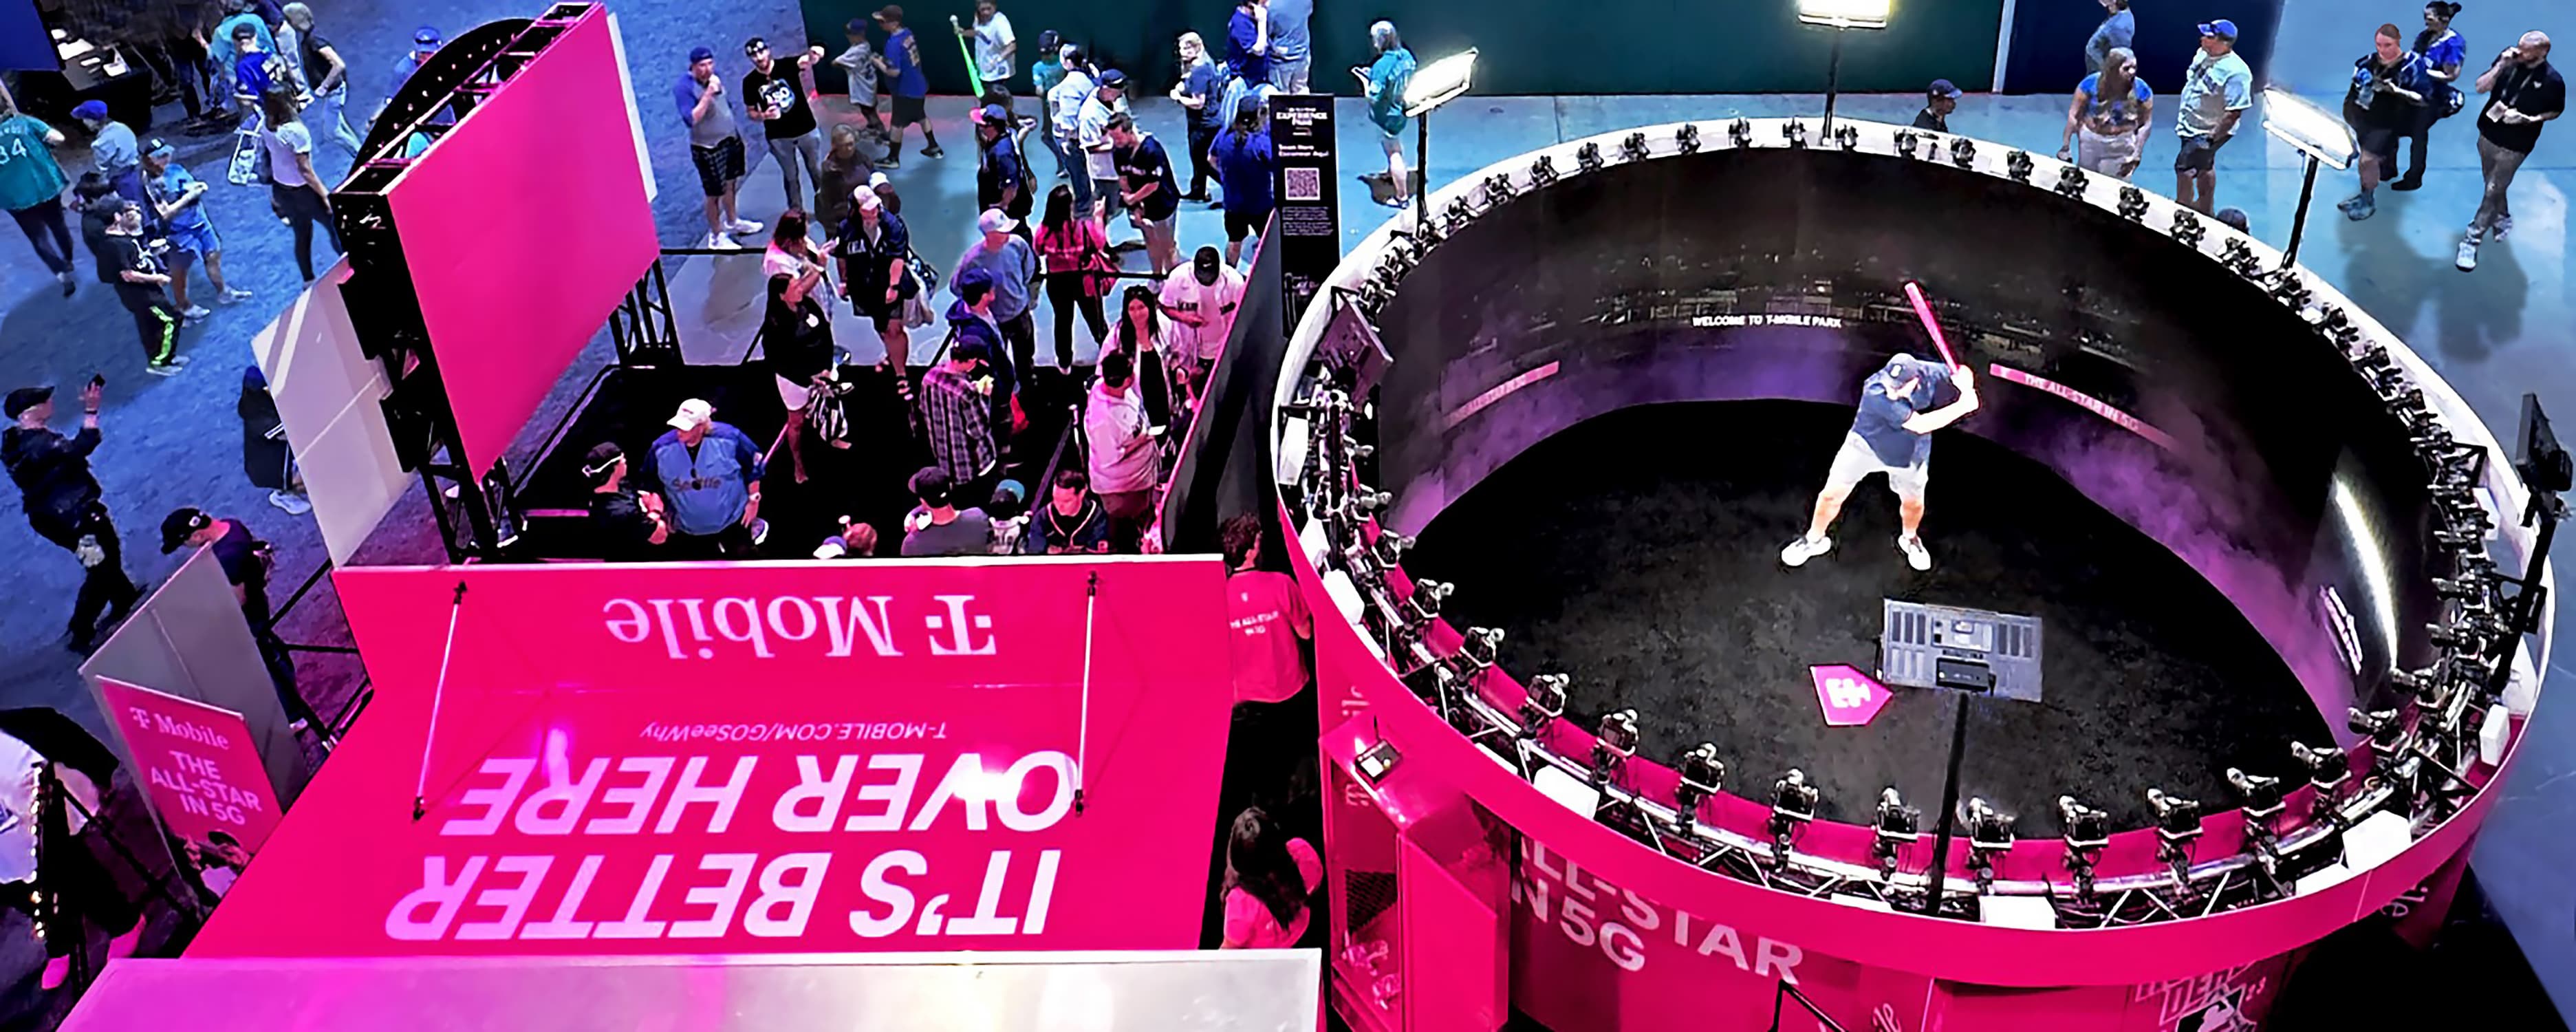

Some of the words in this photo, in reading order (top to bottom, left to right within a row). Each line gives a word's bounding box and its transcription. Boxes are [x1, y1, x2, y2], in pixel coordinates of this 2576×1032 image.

[1693, 314, 1745, 327] WELCOME
[1749, 314, 1762, 325] TO
[1766, 314, 1810, 326] T-MOBILE
[1812, 316, 1842, 328] PARK
[2046, 380, 2102, 414] ALL-STAR
[603, 596, 903, 659] Mobile
[153, 713, 230, 750] Mobile
[640, 722, 946, 742] T-MOBILE.COM/GOSeeWhy
[151, 766, 263, 812] ALL-STAR
[168, 750, 221, 781] THE
[772, 750, 1079, 833] OVER
[179, 793, 209, 817] IN
[211, 802, 246, 825] 5G
[440, 755, 759, 835] HERE
[386, 852, 832, 940] BETTER
[849, 850, 1062, 938] IT'S
[1522, 836, 1804, 985] LL-STAR
[1560, 896, 1645, 971] 5G
